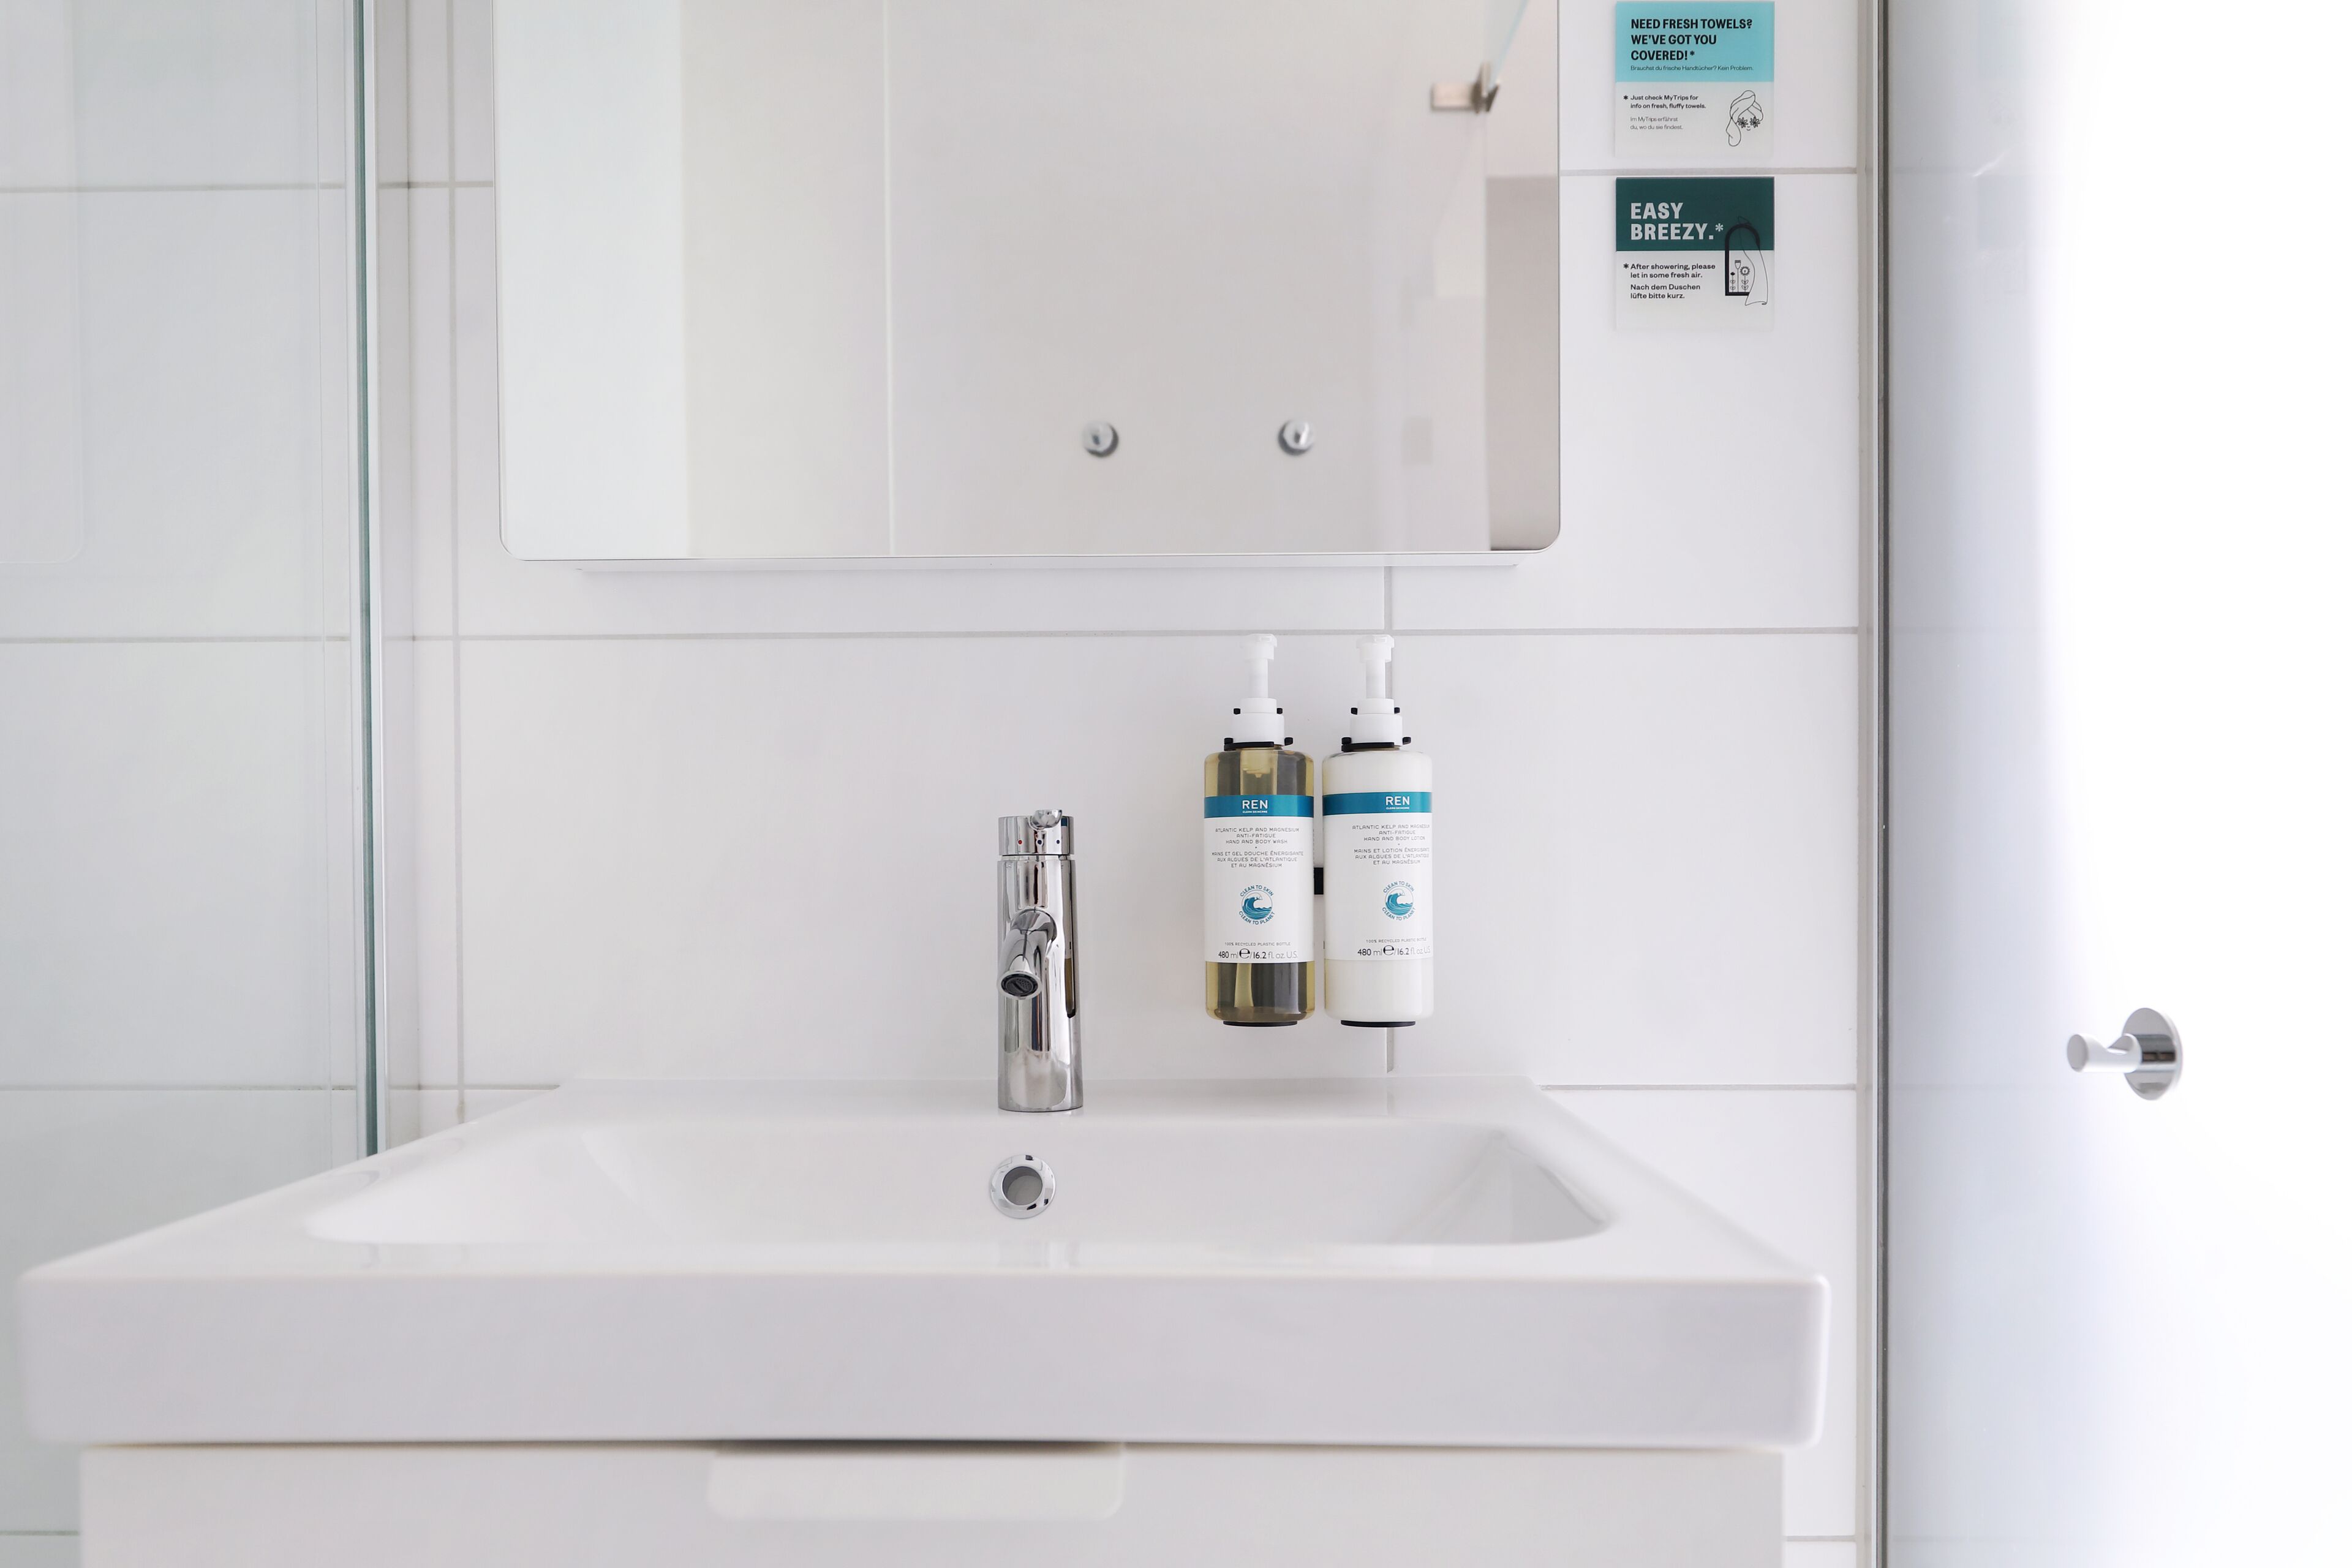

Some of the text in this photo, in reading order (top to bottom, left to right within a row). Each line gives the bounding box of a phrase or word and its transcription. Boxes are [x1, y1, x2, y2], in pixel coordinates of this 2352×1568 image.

[1631, 19, 1752, 29] NEED FRESH TOWELS?
[1631, 35, 1717, 45] WE'VE GOT YOU
[1631, 50, 1688, 61] COVERED!
[1630, 203, 1683, 219] EASY
[1242, 800, 1268, 809] REN
[1385, 796, 1410, 805] REN
[1240, 885, 1255, 897] CLEAN
[1263, 886, 1274, 896] SKIN
[1383, 881, 1398, 894] CLEAN
[1405, 882, 1415, 892] SKIN
[1238, 911, 1252, 924] CLEAN
[1259, 911, 1275, 925] PLANET
[1382, 907, 1395, 920] CLEAN
